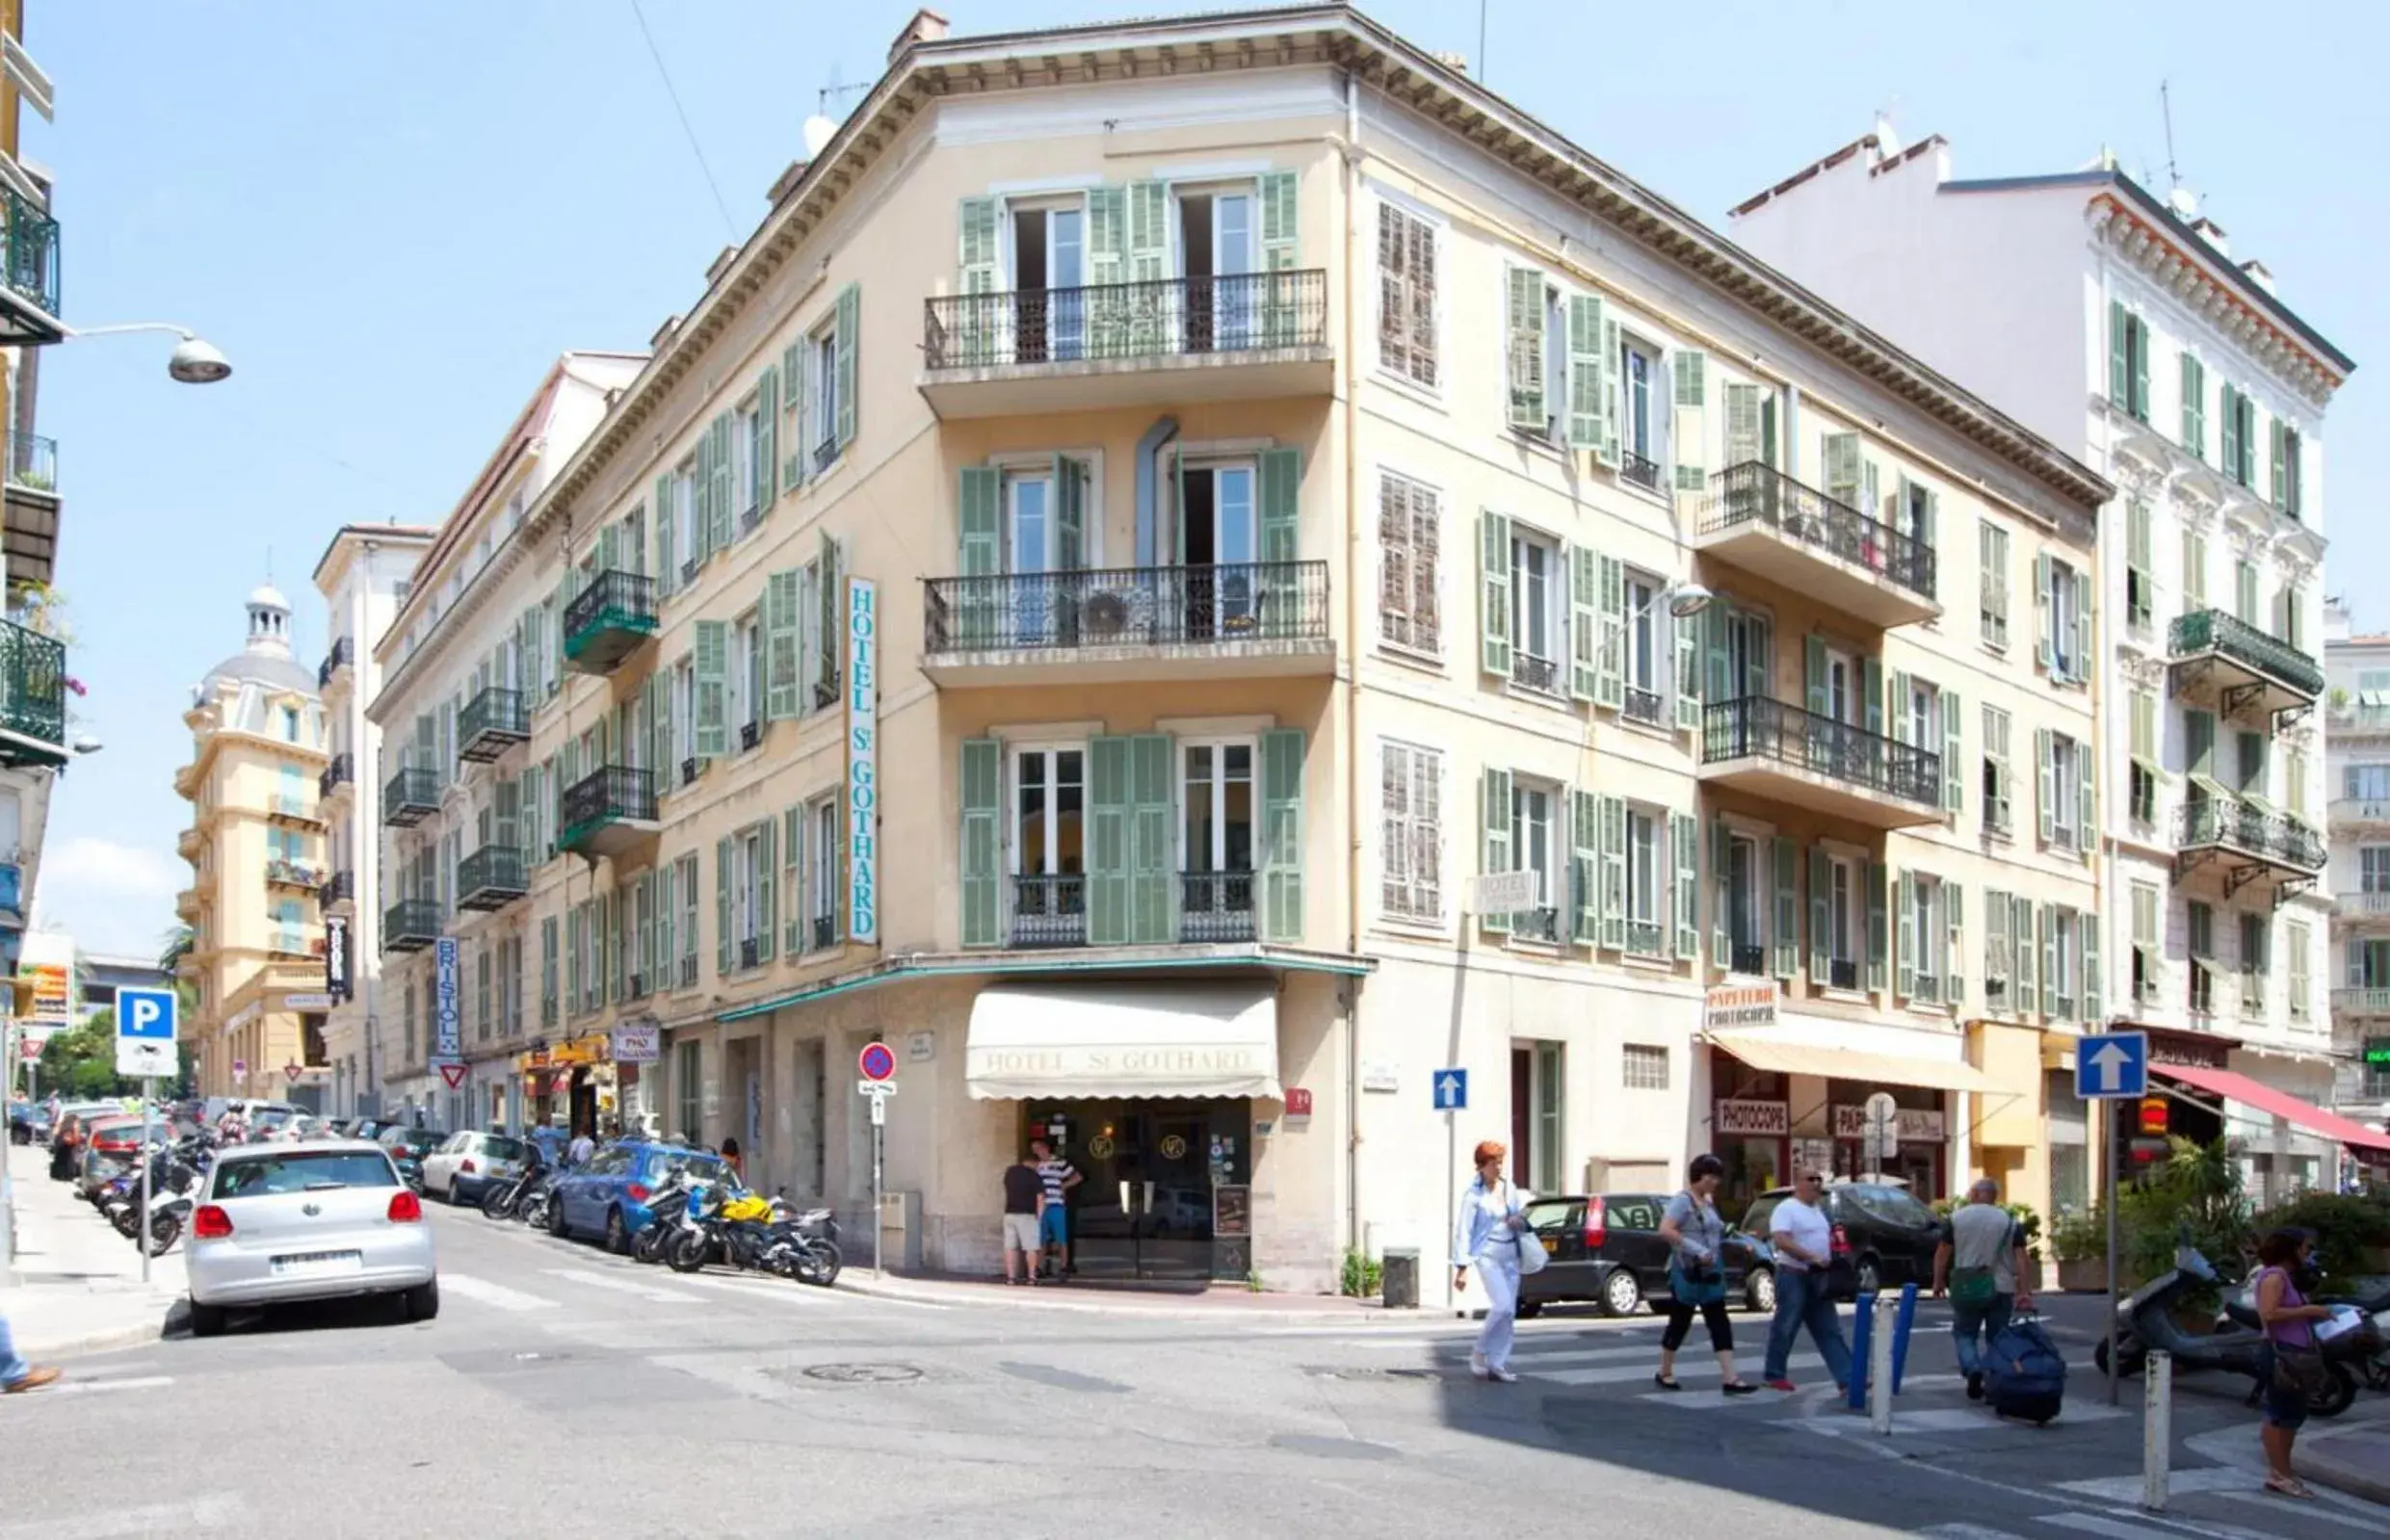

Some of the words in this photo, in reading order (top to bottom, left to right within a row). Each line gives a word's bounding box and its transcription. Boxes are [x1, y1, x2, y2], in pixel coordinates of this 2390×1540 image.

[853, 587, 874, 714] HOTEL
[852, 760, 875, 935] GOTHARD
[132, 998, 161, 1031] P
[439, 940, 457, 1036] BRISTOL
[985, 1051, 1067, 1073] HOTEL
[1121, 1049, 1252, 1072] GOTHARD
